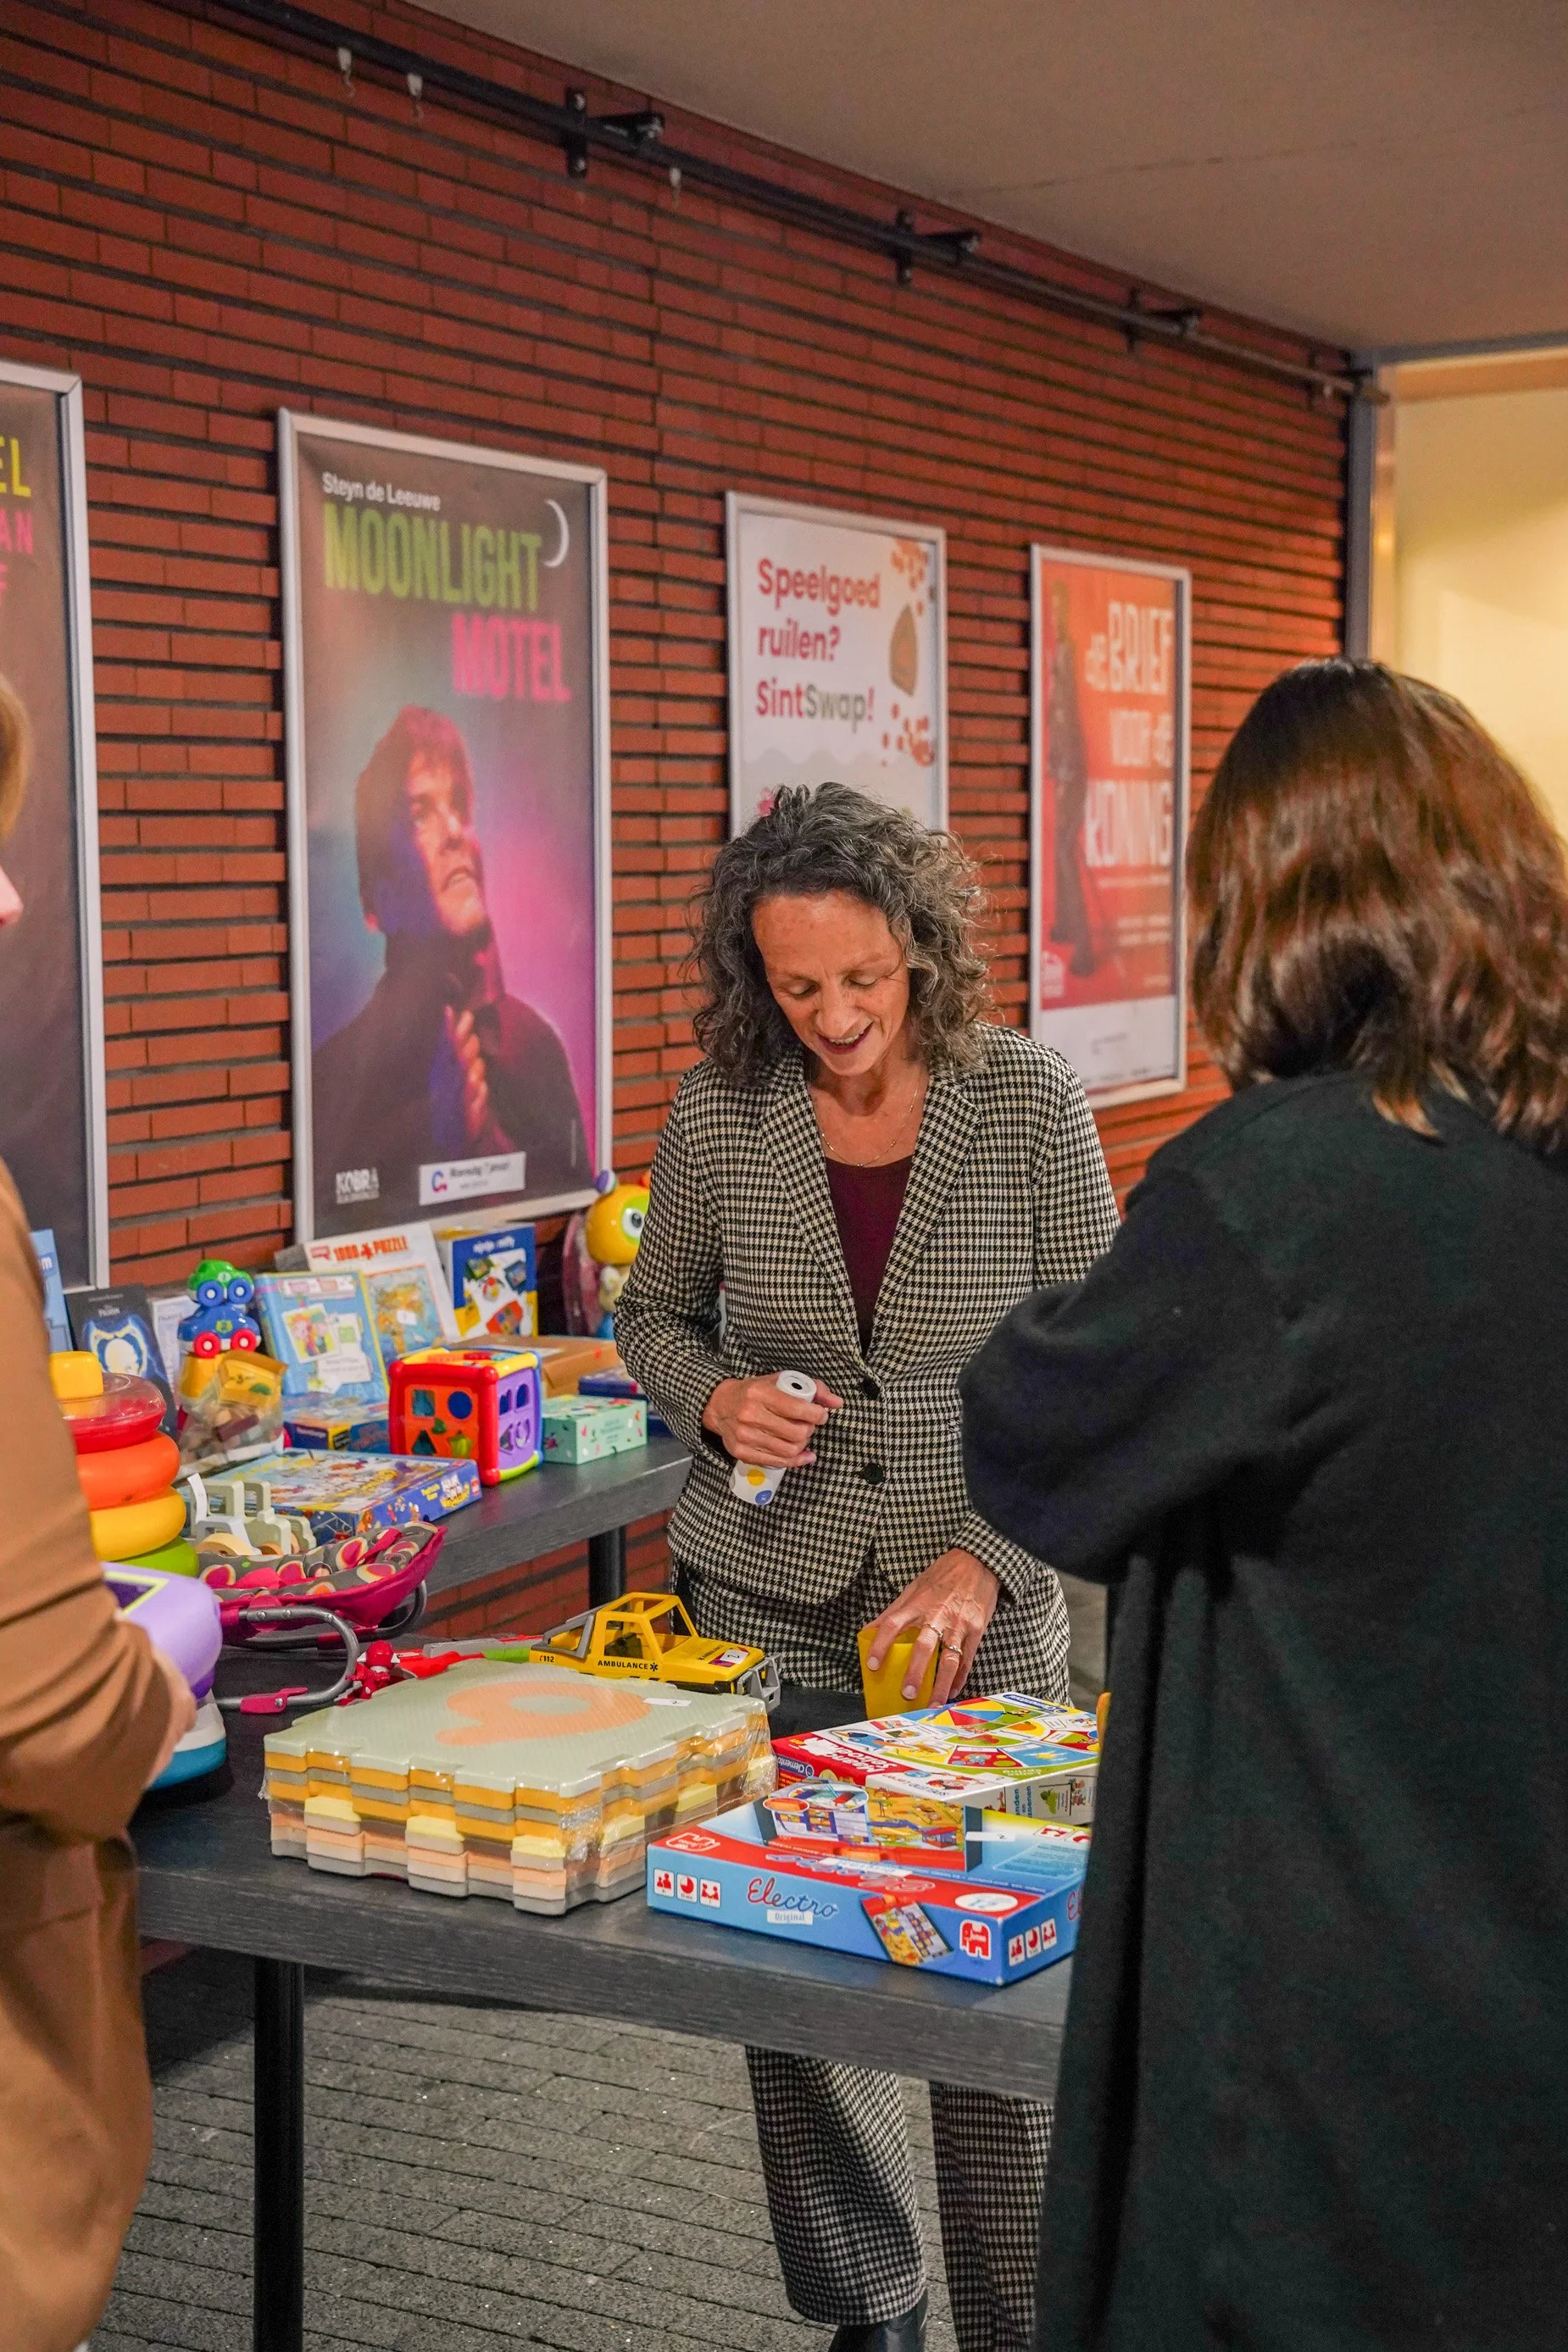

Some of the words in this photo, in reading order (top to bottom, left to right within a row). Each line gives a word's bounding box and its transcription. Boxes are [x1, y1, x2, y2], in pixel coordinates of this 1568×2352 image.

[322, 471, 364, 502] Steyn
[365, 481, 385, 503] de
[386, 482, 442, 512] Leeuwe
[322, 501, 542, 612] MOONLIGHT
[757, 558, 881, 617] Speelgoed
[452, 612, 572, 703] MOTEL
[758, 618, 841, 662] ruilen?
[756, 676, 876, 734] SintSwap!
[598, 1660, 648, 1670] AMBULANCE
[746, 1876, 839, 1919] Electro
[774, 1912, 805, 1923] Original
